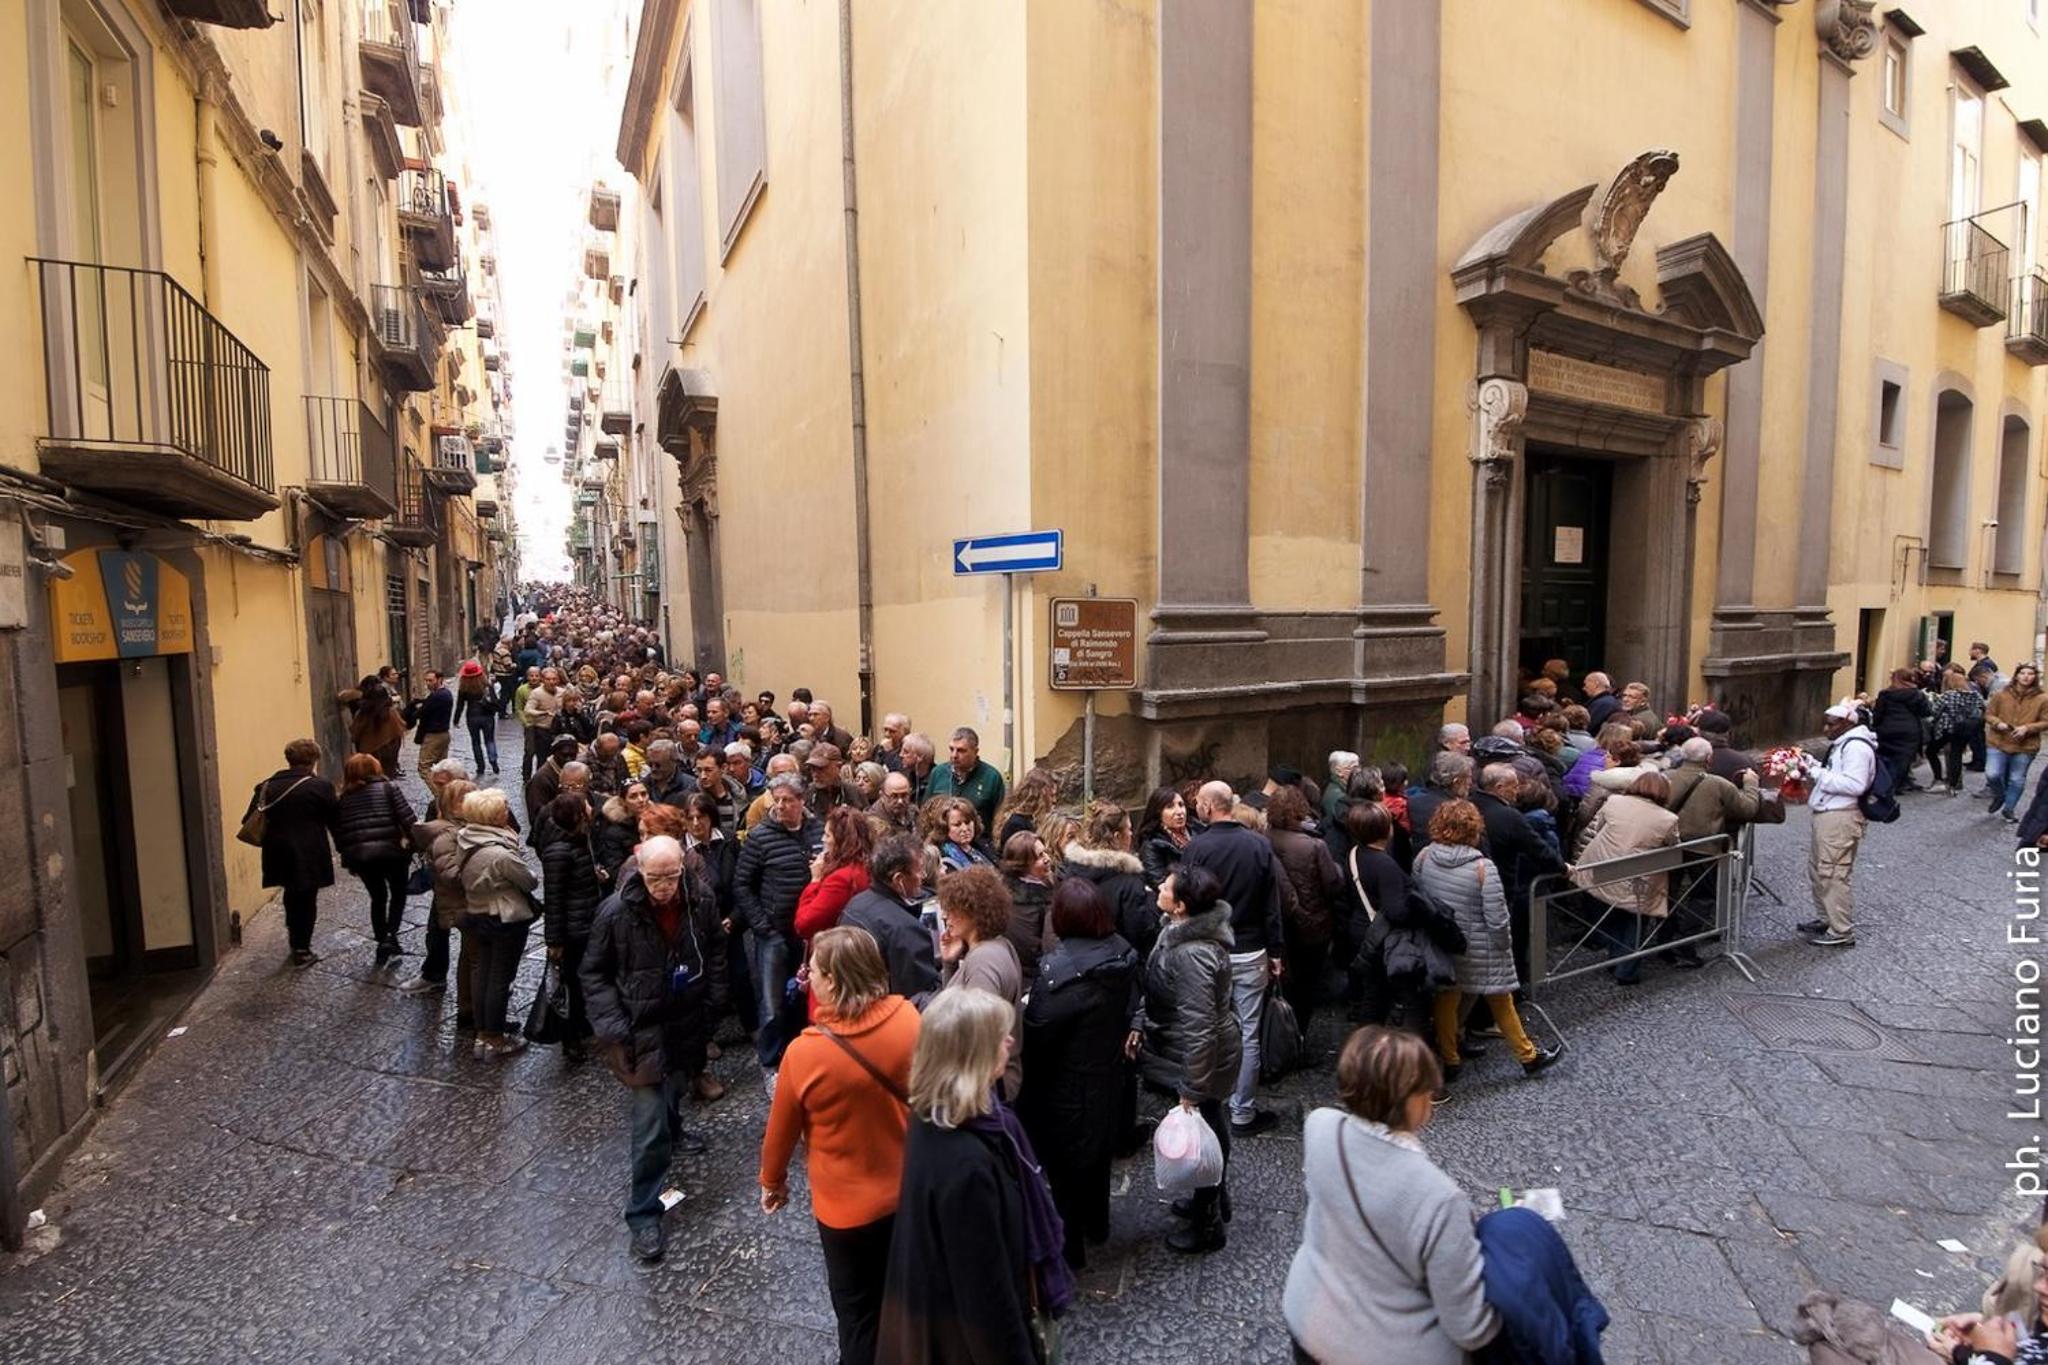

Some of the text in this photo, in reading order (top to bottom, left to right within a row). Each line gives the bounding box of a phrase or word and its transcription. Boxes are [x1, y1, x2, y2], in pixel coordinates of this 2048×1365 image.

[1057, 629, 1131, 639] Cappella Sansevero
[1070, 639, 1118, 648] di Raimondo
[1076, 648, 1085, 657] di
[1085, 648, 1113, 660] Sangro
